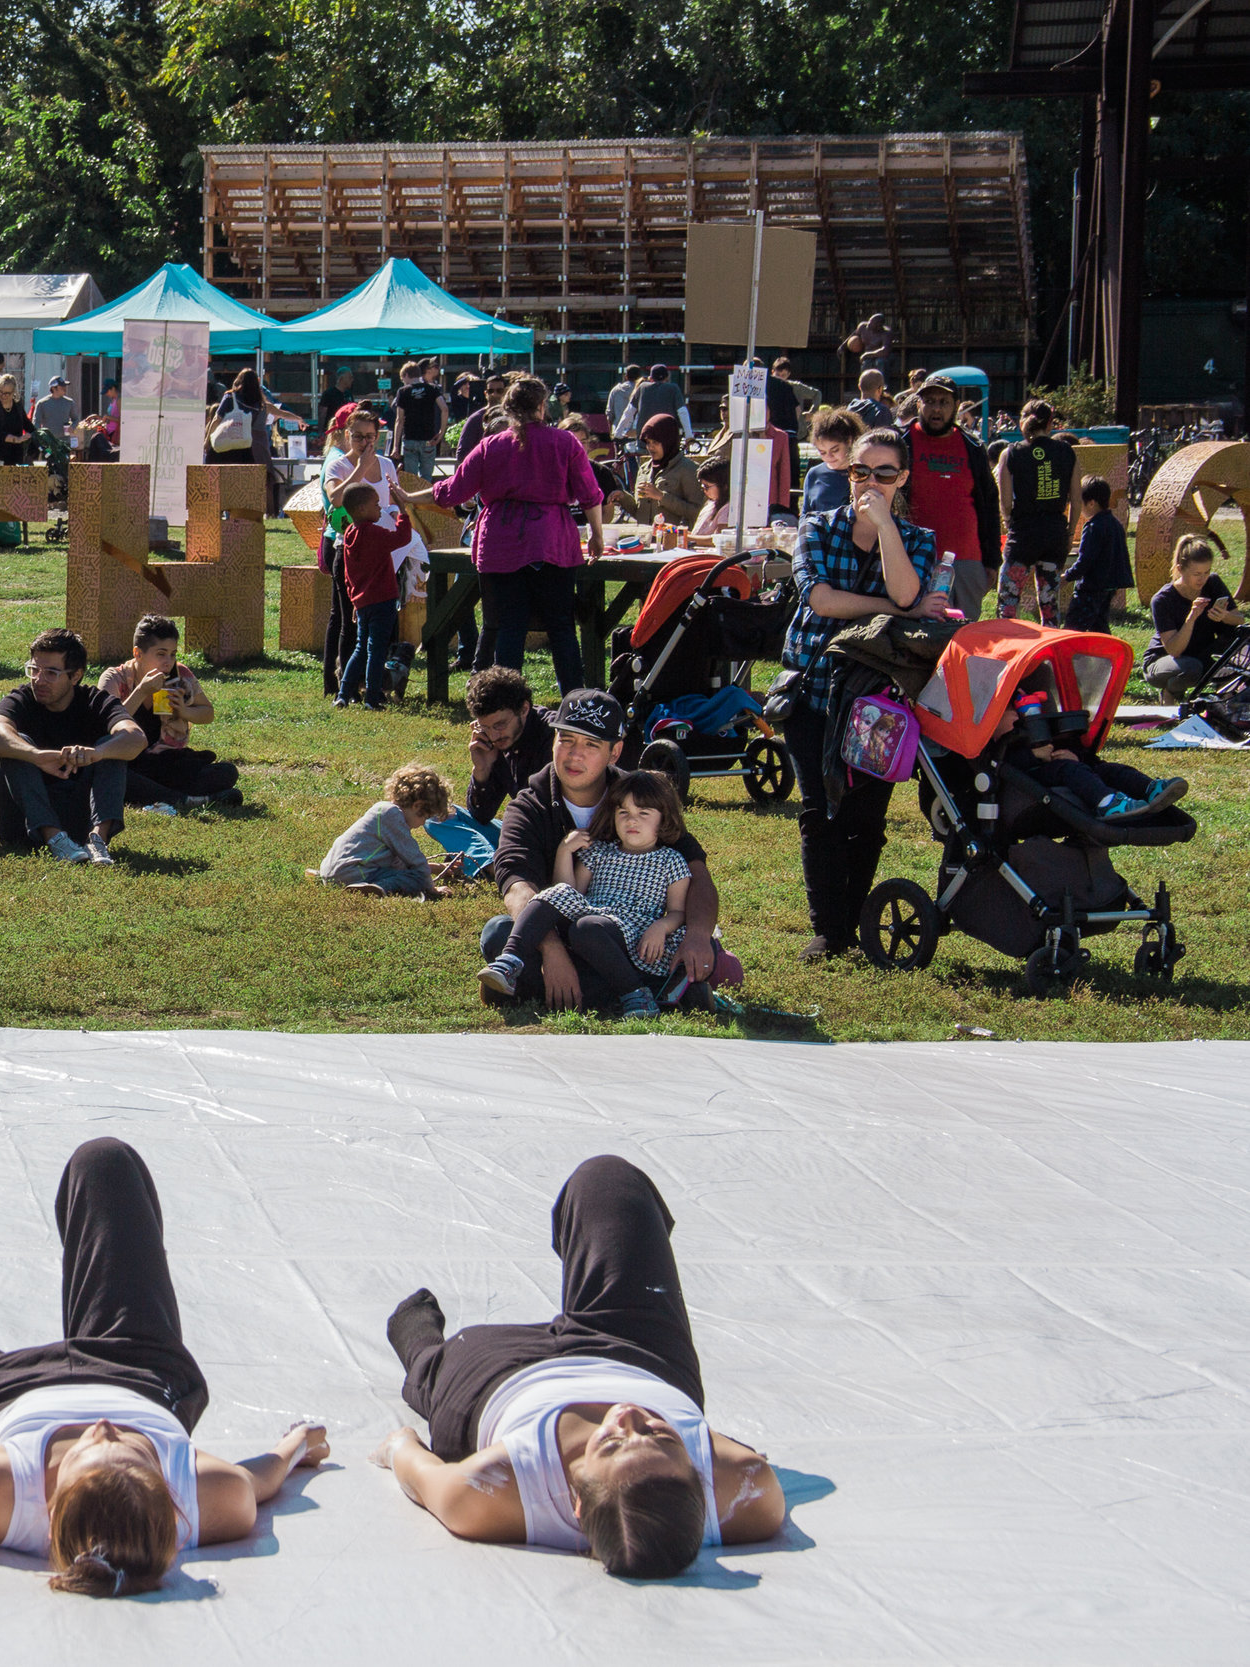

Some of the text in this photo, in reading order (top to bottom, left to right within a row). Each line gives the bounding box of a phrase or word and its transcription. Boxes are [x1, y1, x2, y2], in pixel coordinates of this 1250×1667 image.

[1203, 358, 1215, 374] 4
[1037, 465, 1045, 497] SOCRATES
[1044, 460, 1052, 497] SCULPTURE
[1052, 478, 1060, 496] PARK
